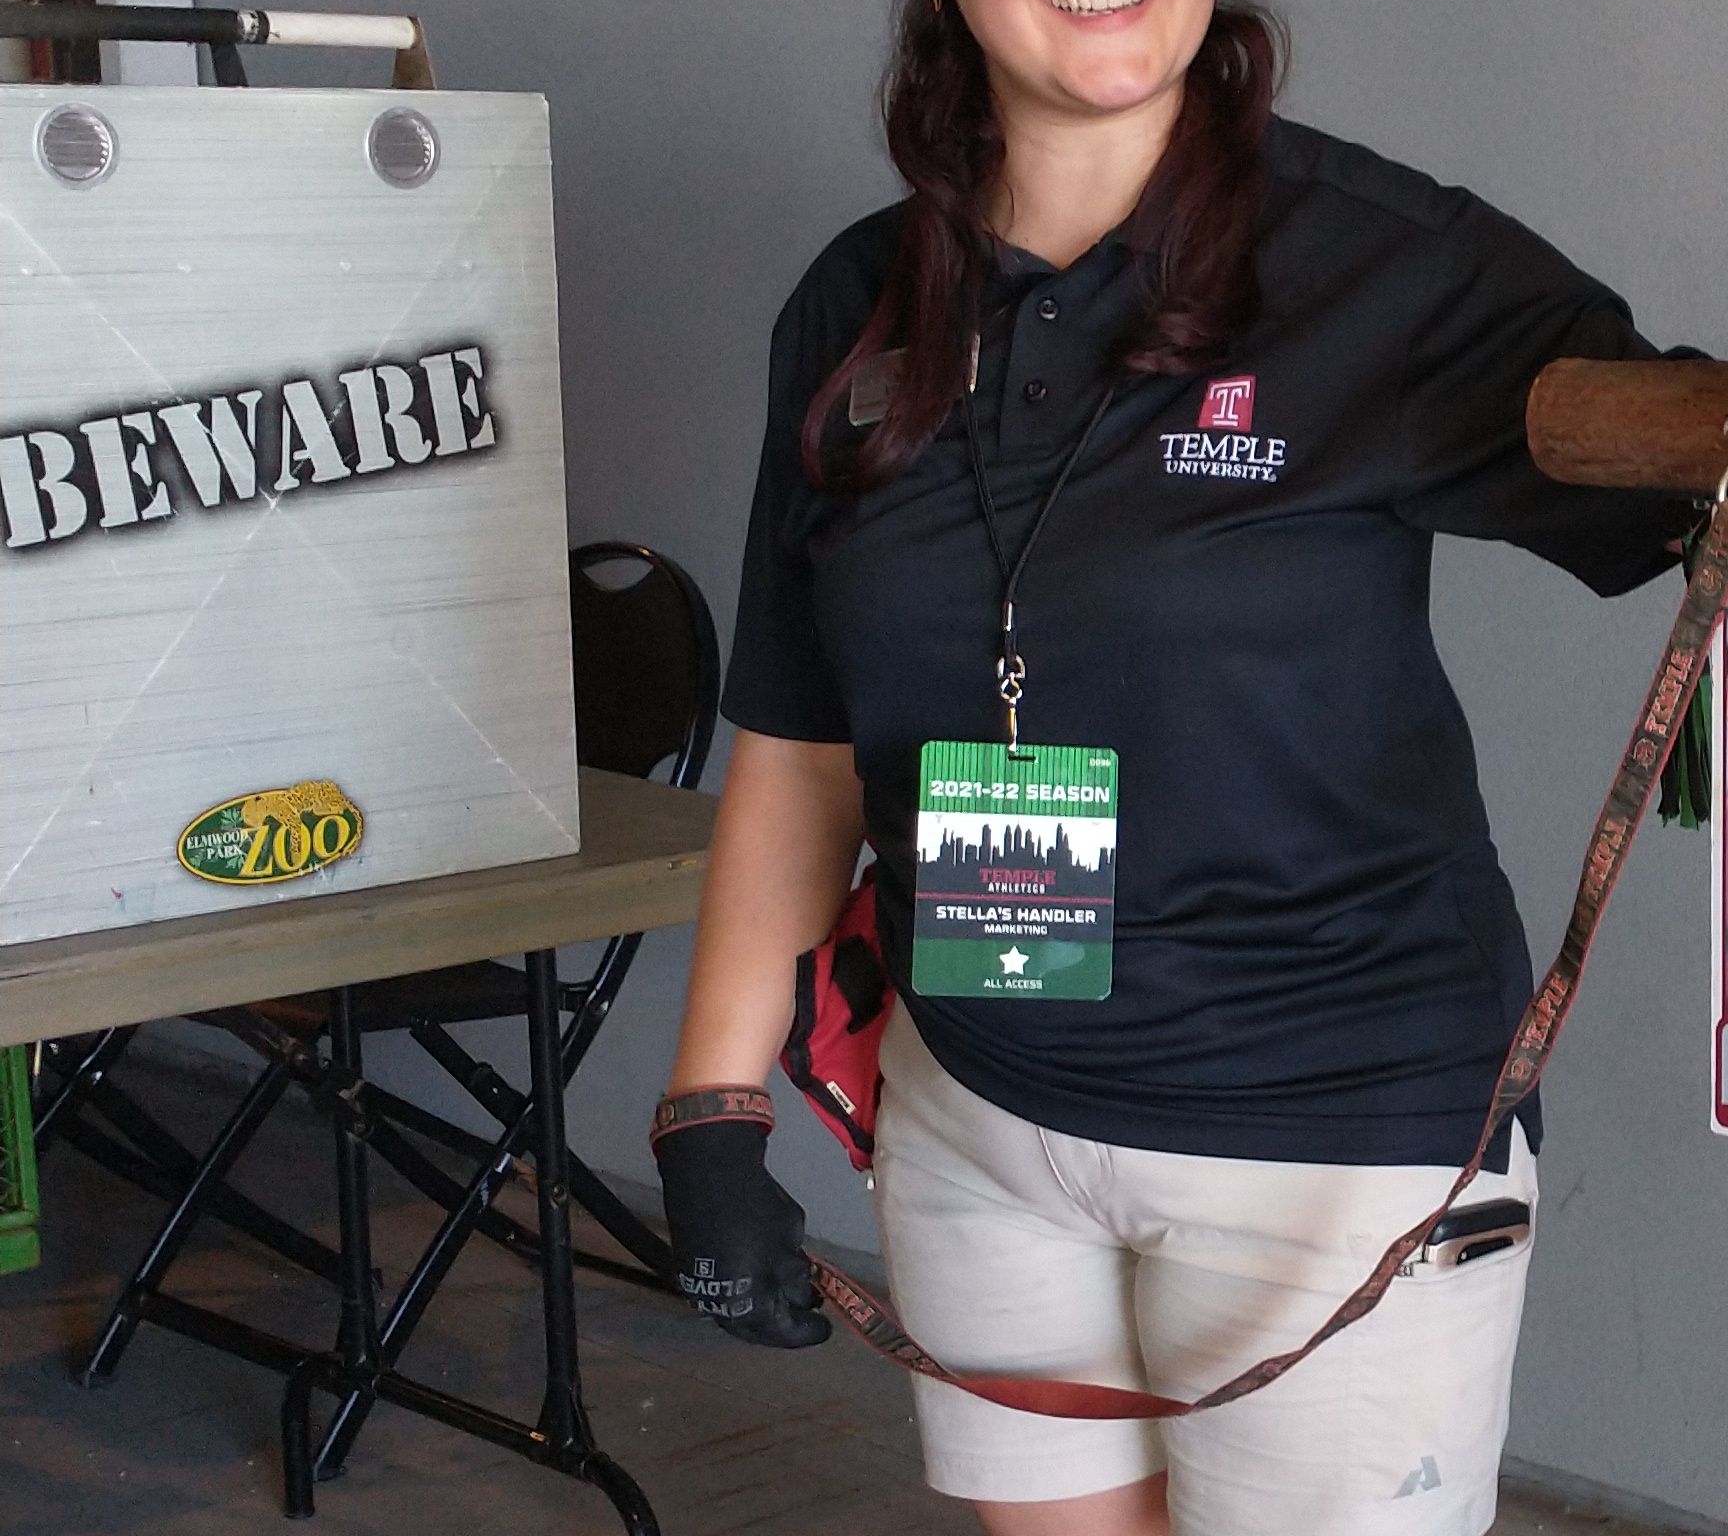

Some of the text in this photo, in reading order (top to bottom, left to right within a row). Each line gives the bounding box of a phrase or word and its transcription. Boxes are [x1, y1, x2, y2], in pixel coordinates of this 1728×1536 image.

[0, 347, 496, 547] BEWARE
[1159, 432, 1286, 466] TEMPLE
[1165, 459, 1275, 482] UNIVERSITY
[930, 779, 1110, 804] 2021-22 SEASON
[186, 828, 248, 850] ELMWOOD
[239, 814, 350, 877] ZOO
[206, 843, 246, 860] PARK
[979, 867, 1056, 885] TEMPLE
[987, 882, 1046, 894] ATHLETICS
[936, 905, 1097, 924] STELLA'S HANDLER
[984, 923, 1048, 935] MARKETING
[983, 978, 1043, 990] ALL ACCESS
